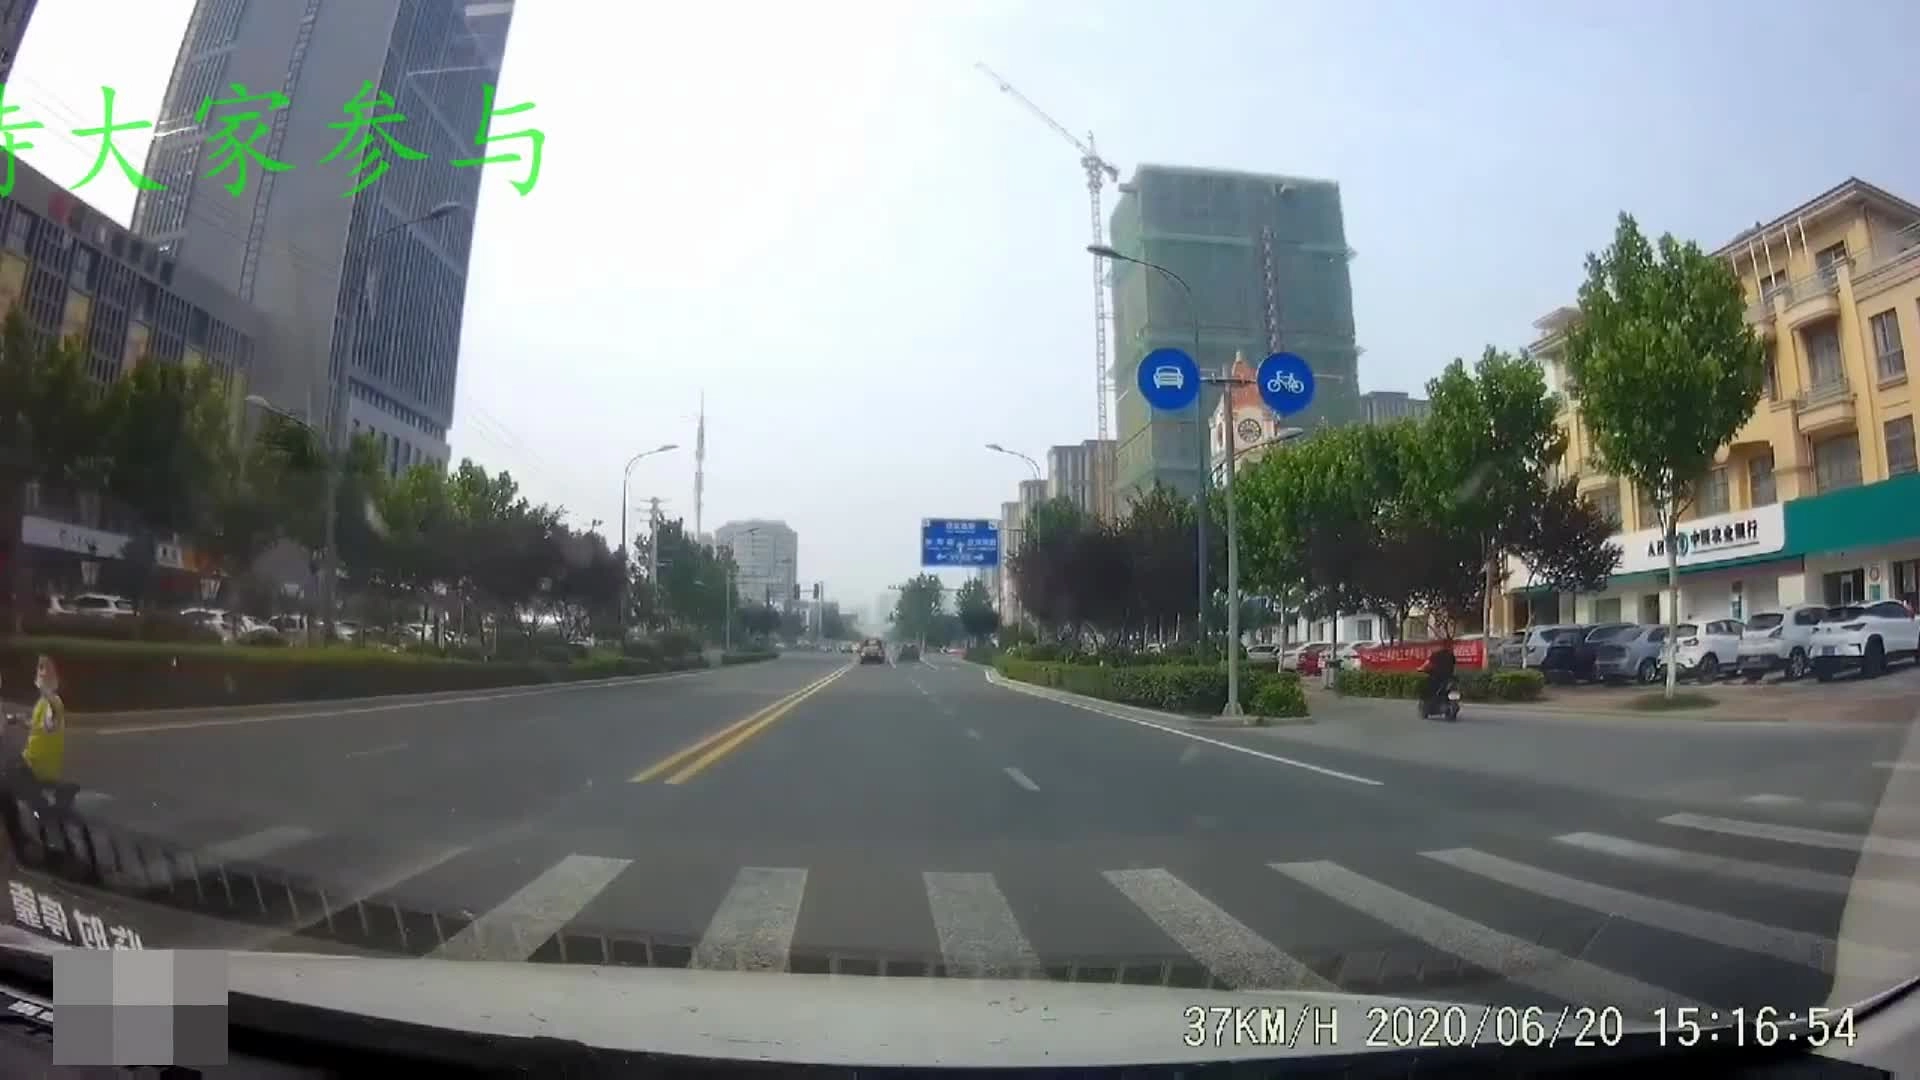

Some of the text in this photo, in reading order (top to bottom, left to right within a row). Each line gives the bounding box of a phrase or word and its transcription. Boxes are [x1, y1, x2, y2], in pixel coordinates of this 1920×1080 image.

[1690, 519, 1759, 548] 中国农业银行
